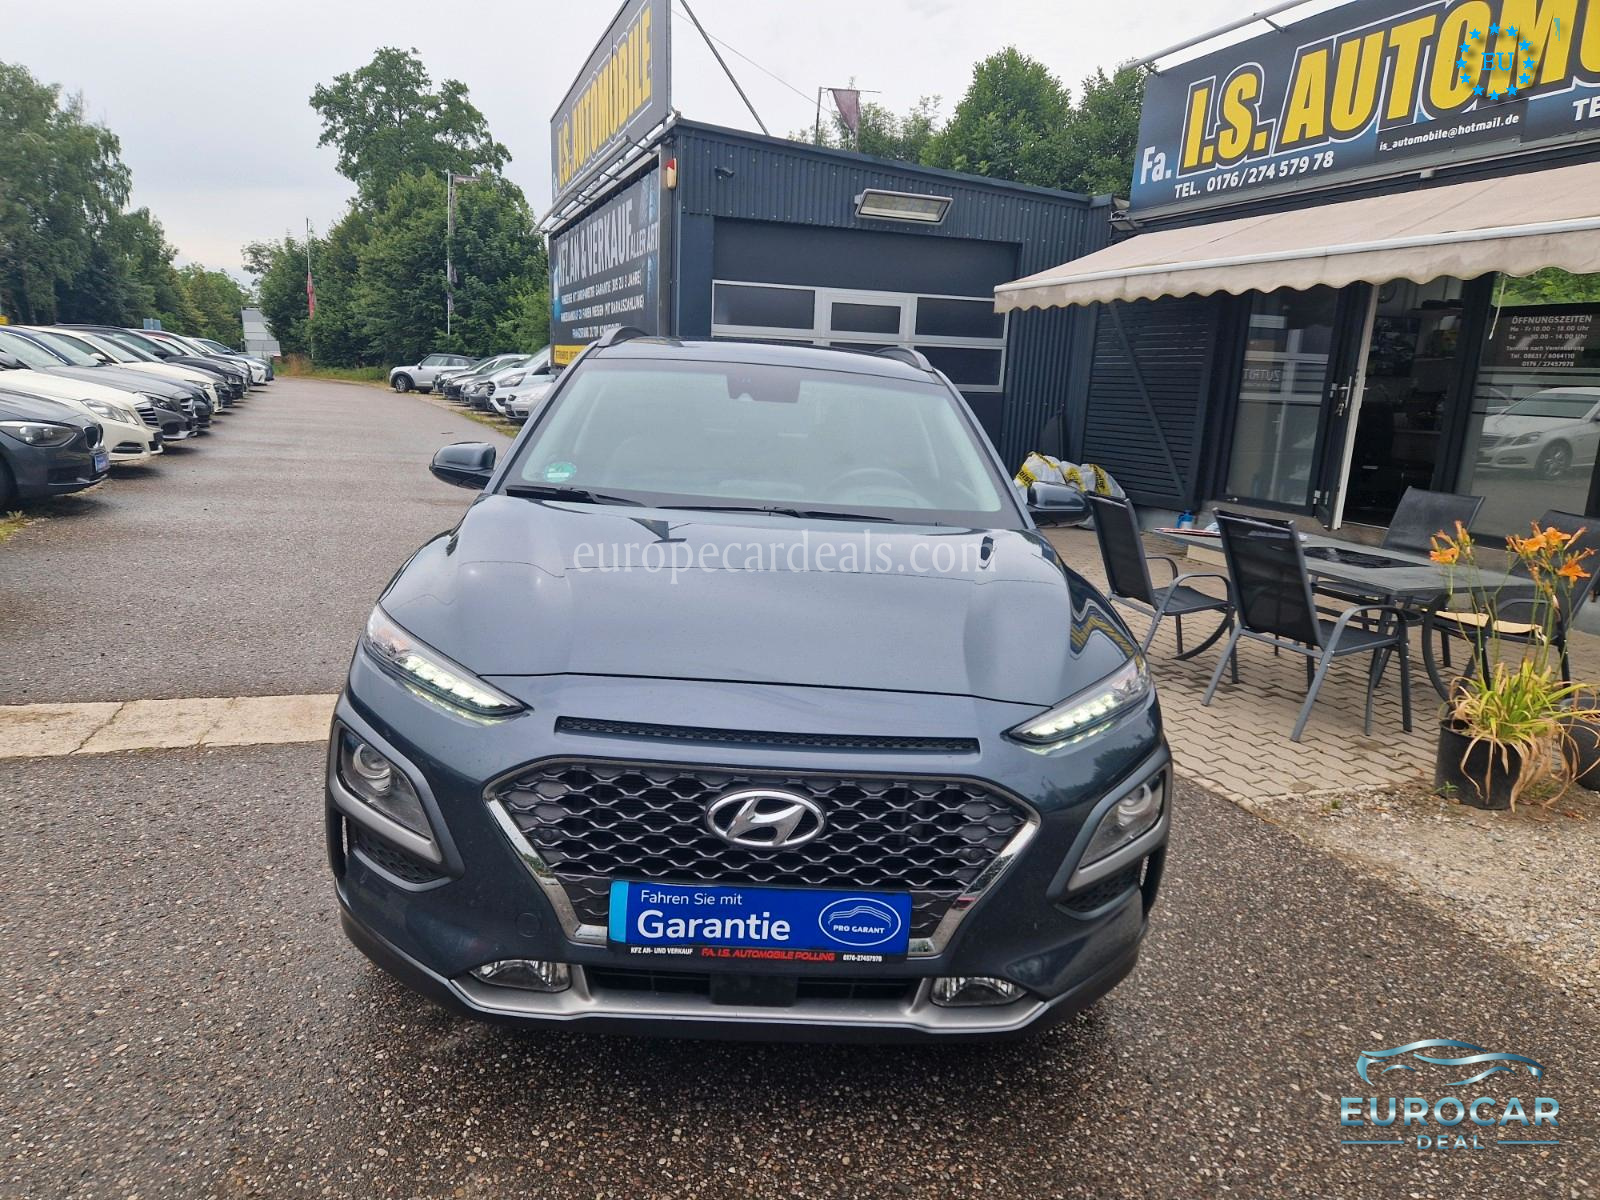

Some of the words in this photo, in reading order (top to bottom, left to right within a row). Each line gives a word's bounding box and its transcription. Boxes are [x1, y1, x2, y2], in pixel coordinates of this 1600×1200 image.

[572, 6, 651, 177] AUTOMOBILE
[1183, 73, 1268, 168] I.S.
[1379, 114, 1519, 151] is_automobile@hotmail.de
[1140, 146, 1172, 184] Fa.
[1174, 181, 1201, 199] TEL.
[587, 198, 632, 277] VERKAUF
[1511, 315, 1593, 324] ÖFFNUNGSZEITEN
[641, 890, 689, 905] Fahren
[694, 892, 715, 905] Sie
[720, 892, 743, 905] mit
[637, 909, 791, 941] Garantie
[833, 924, 850, 932] PRO
[851, 926, 885, 934] GARANT
[667, 947, 693, 955] VERKAUF
[732, 948, 794, 960] AUTOMOBILE
[795, 951, 836, 961] POLLING
